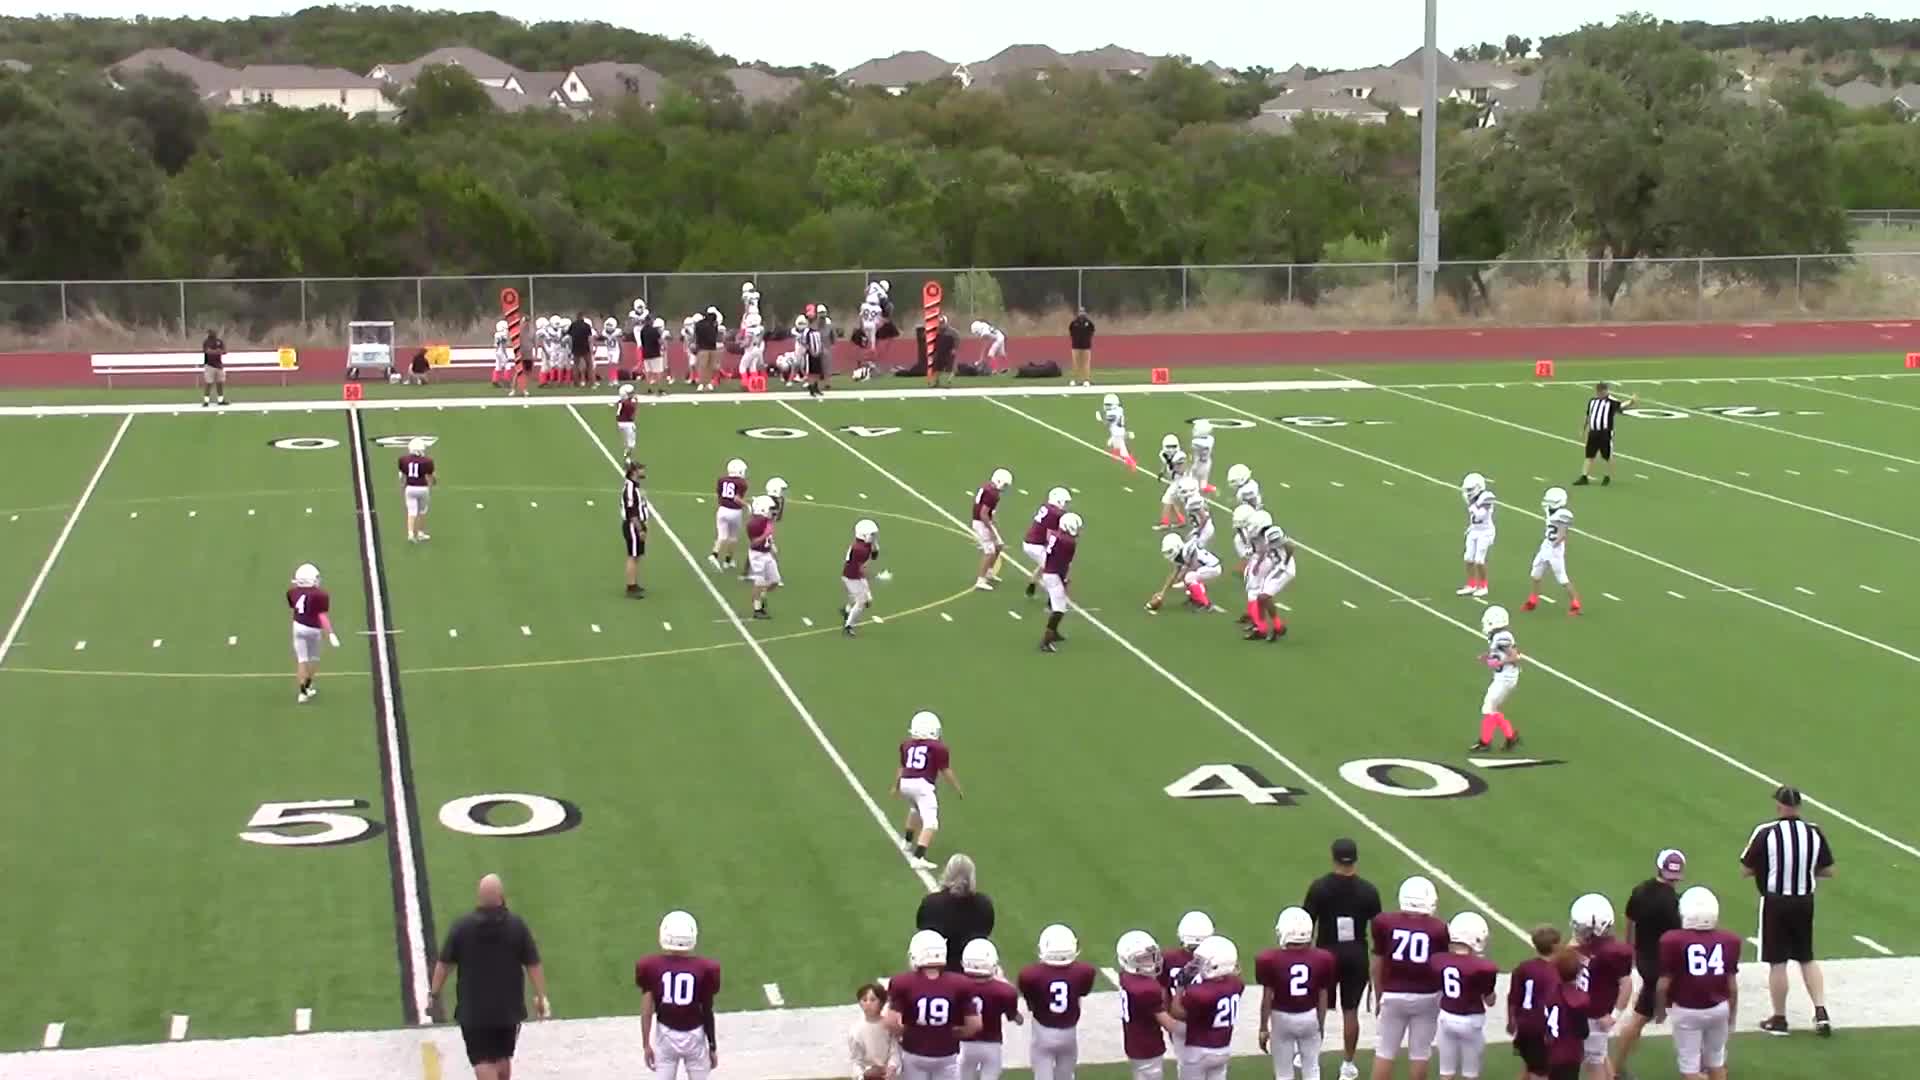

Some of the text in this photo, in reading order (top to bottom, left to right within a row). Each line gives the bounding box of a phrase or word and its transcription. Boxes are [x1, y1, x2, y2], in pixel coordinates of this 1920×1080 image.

[345, 385, 360, 398] 50
[408, 462, 419, 478] 11
[722, 481, 736, 498] 16
[295, 594, 307, 613] 4
[906, 746, 928, 769] 15
[1392, 929, 1430, 963] 70
[1687, 943, 1725, 976] 64
[661, 971, 696, 1006] 10
[1290, 964, 1309, 996] 2
[1443, 967, 1461, 998] 6
[916, 997, 950, 1026] 19
[1049, 981, 1068, 1013] 3
[1213, 994, 1241, 1028] 20
[1544, 1004, 1560, 1038] 4
